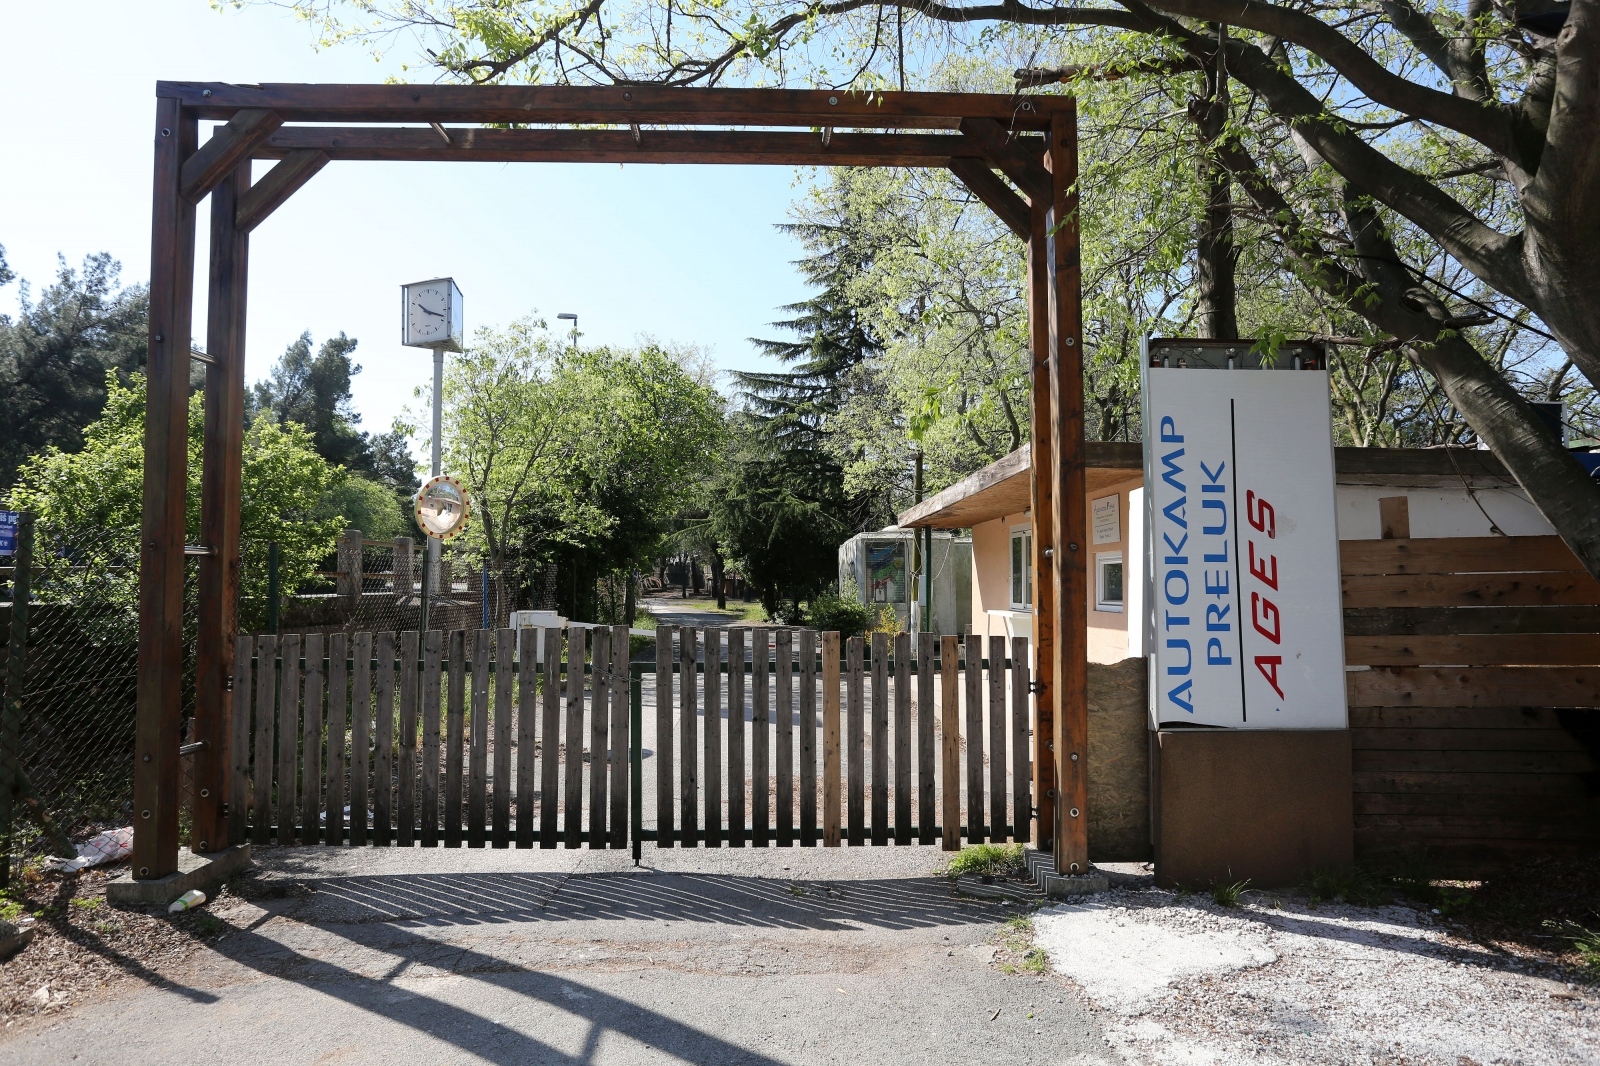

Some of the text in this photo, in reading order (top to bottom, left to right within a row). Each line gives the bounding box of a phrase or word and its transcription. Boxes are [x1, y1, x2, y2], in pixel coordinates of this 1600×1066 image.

[1160, 416, 1194, 713] AUTOKAMP
[1200, 461, 1233, 666] PRELUK
[1246, 489, 1284, 701] AGES
